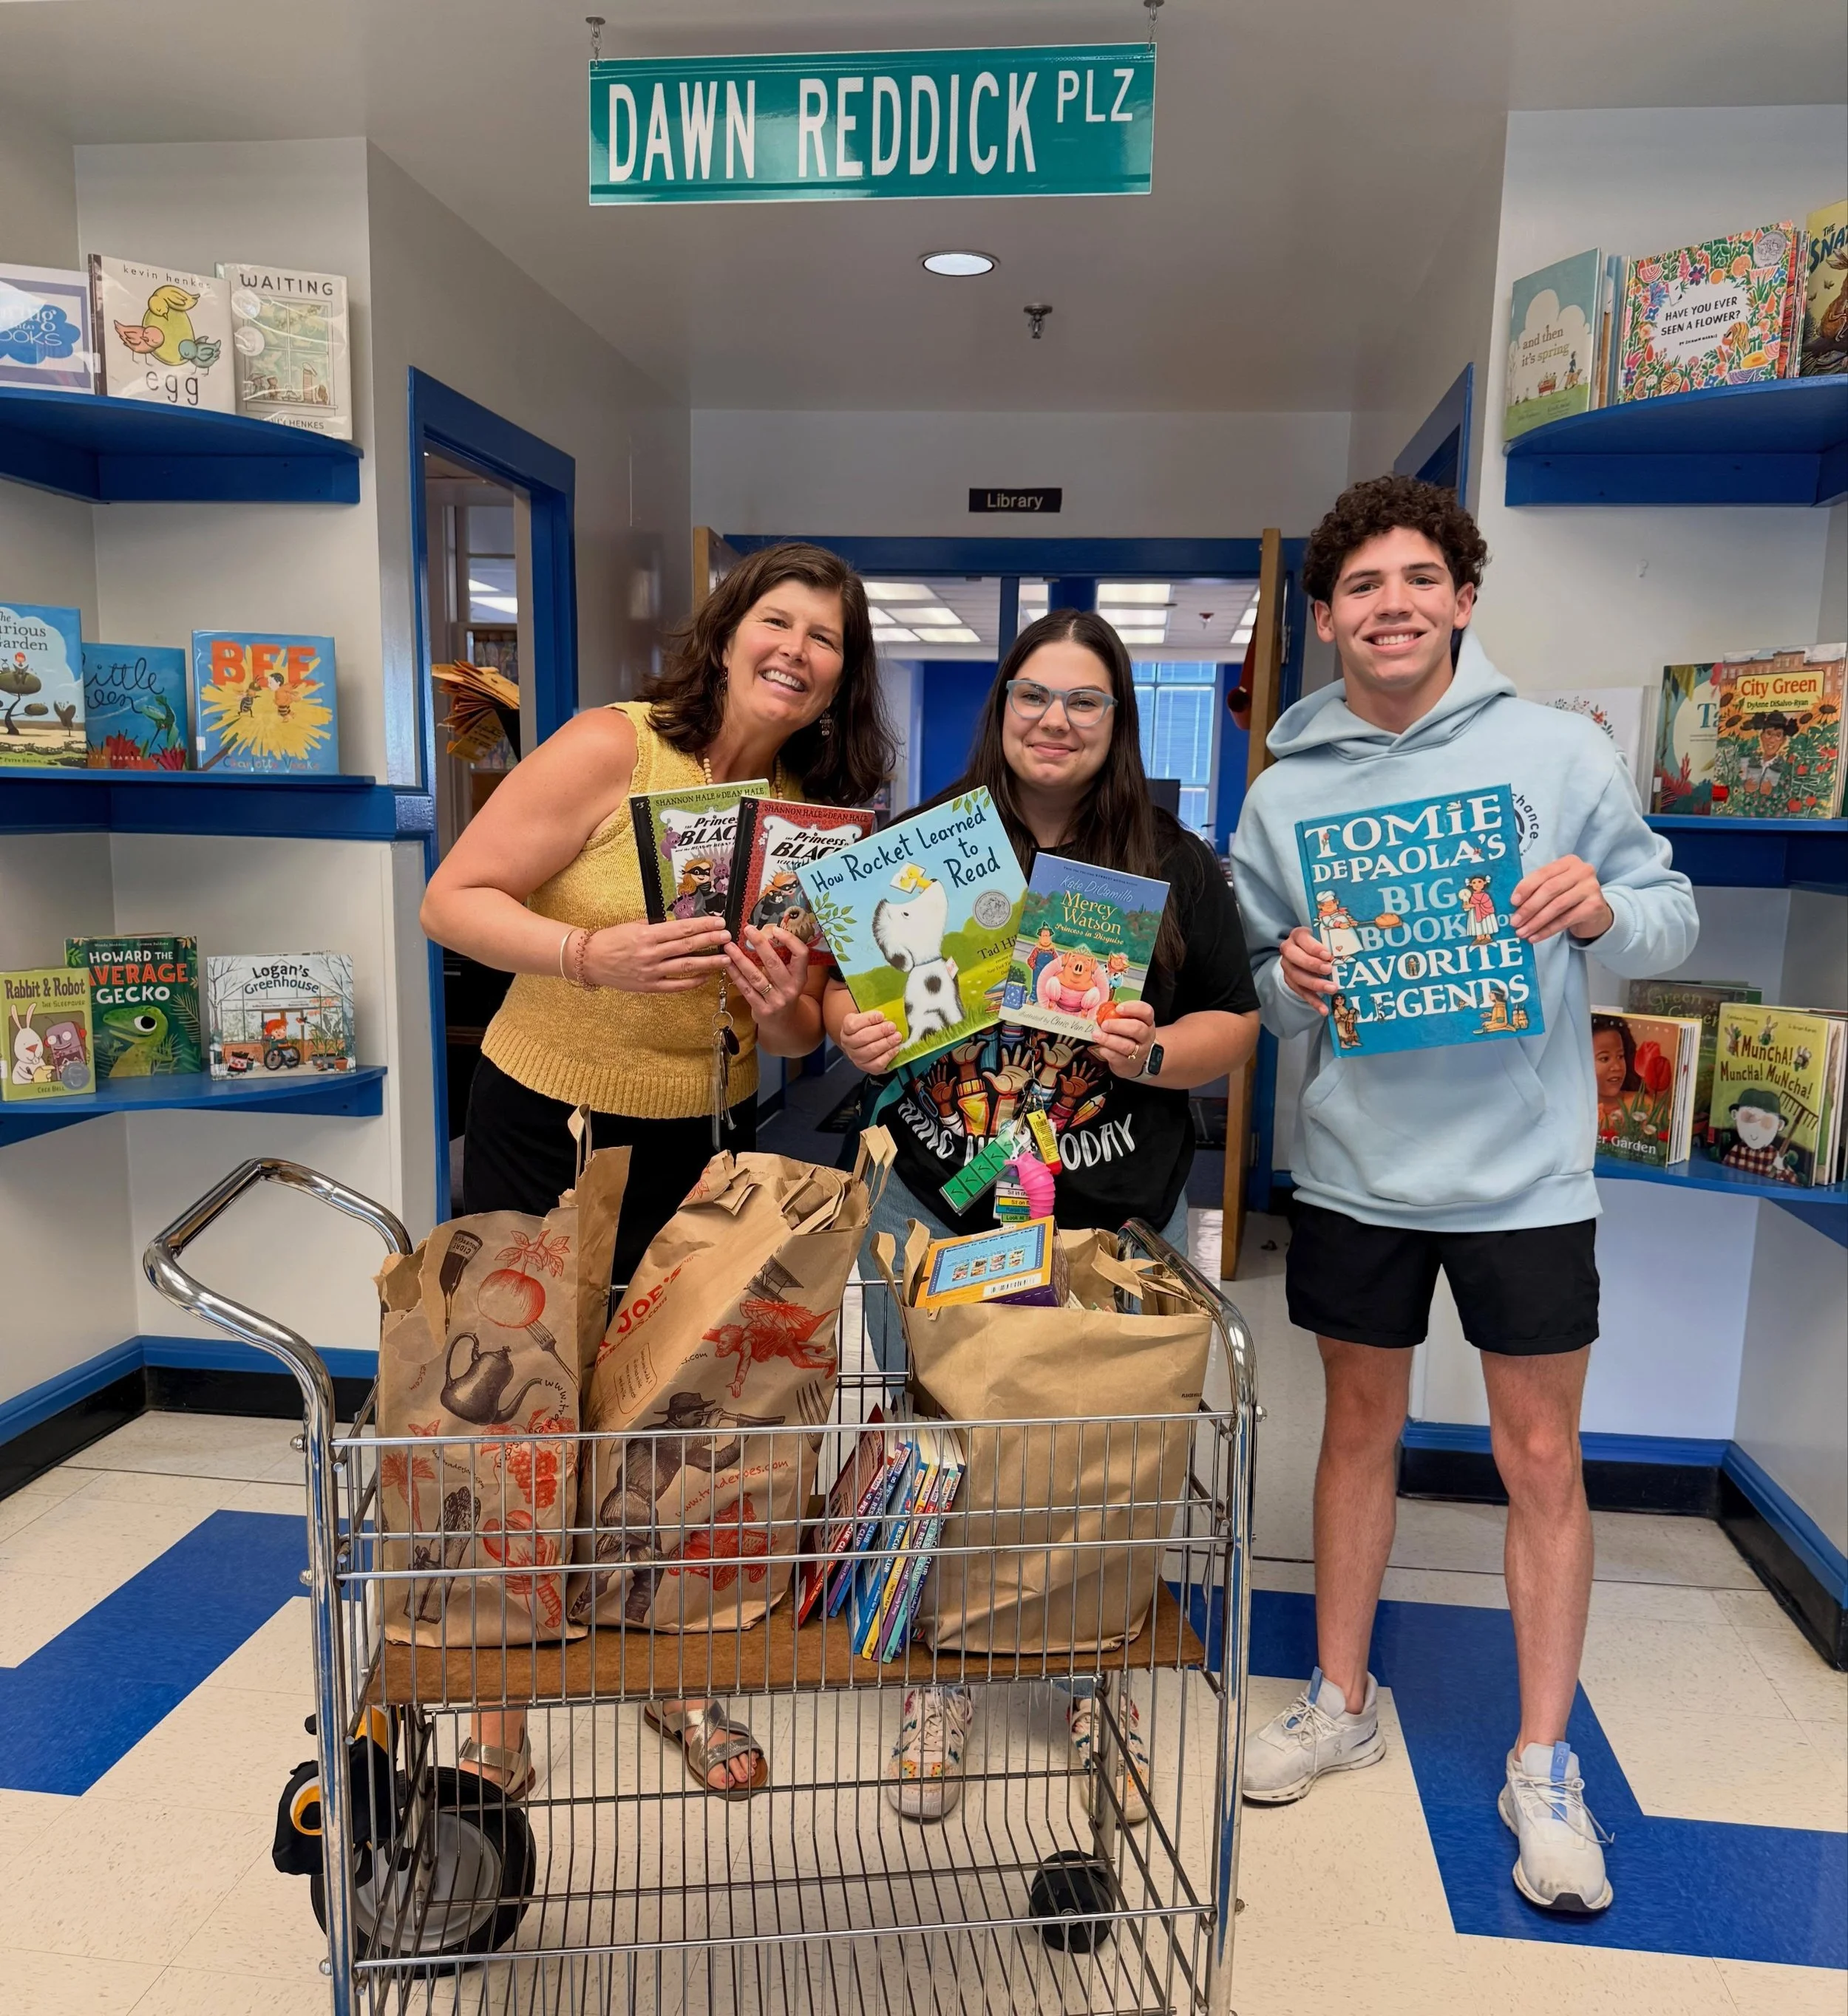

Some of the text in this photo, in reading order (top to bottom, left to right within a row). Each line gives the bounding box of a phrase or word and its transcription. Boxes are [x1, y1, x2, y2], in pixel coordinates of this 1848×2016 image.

[608, 69, 1135, 183] DAWN REDDICK PLZ
[1823, 223, 1835, 236] THE
[123, 265, 211, 290] kevin henkes
[240, 273, 335, 296] WAITING
[1665, 296, 1737, 321] HAVE YOU EVER
[1661, 310, 1741, 336] SEEN A FLOWER?
[1523, 324, 1563, 350] and then
[1522, 343, 1569, 367] it's spring
[145, 370, 200, 405] egg
[289, 419, 325, 429] HENKES
[987, 493, 1044, 511] Library
[0, 637, 48, 651] arden
[83, 652, 165, 695] ittle
[211, 641, 316, 688] BEE
[1741, 678, 1817, 698] City Green
[656, 797, 694, 806] SHANNON
[696, 793, 716, 802] HALE
[721, 790, 742, 800] DEAN
[744, 788, 764, 796] HALE
[694, 815, 738, 828] Princes
[764, 804, 802, 816] SHANNON
[803, 809, 823, 818] HALE
[827, 812, 848, 820] DEAN
[678, 825, 738, 847] BLAC
[793, 831, 846, 846] Princess
[771, 842, 843, 860] BLAC
[812, 806, 987, 893] How Rocket Learned
[959, 838, 979, 859] to
[943, 847, 1001, 888] Read
[1061, 875, 1133, 903] Kate DiCamillo
[1378, 877, 1458, 916] BIG
[1061, 890, 1118, 920] Mercy
[1063, 906, 1121, 936] Watson
[1055, 922, 1083, 936] Princess
[1093, 931, 1124, 945] Disguise
[1359, 914, 1467, 952] BOOK
[89, 950, 173, 964] HOWARD THE
[977, 943, 1000, 959] Tad
[252, 964, 310, 978] Logan's
[1331, 937, 1523, 990] FAVORITE
[4, 976, 86, 999] Rabbit & Robot
[95, 985, 170, 1004] GECKO
[245, 975, 319, 994] Greenhouse
[1349, 974, 1529, 1024] LEGENDS
[1050, 1015, 1069, 1029] Chris
[1070, 1018, 1083, 1031] Van
[1059, 1113, 1136, 1171] ODAY
[1611, 1136, 1656, 1154] Garden
